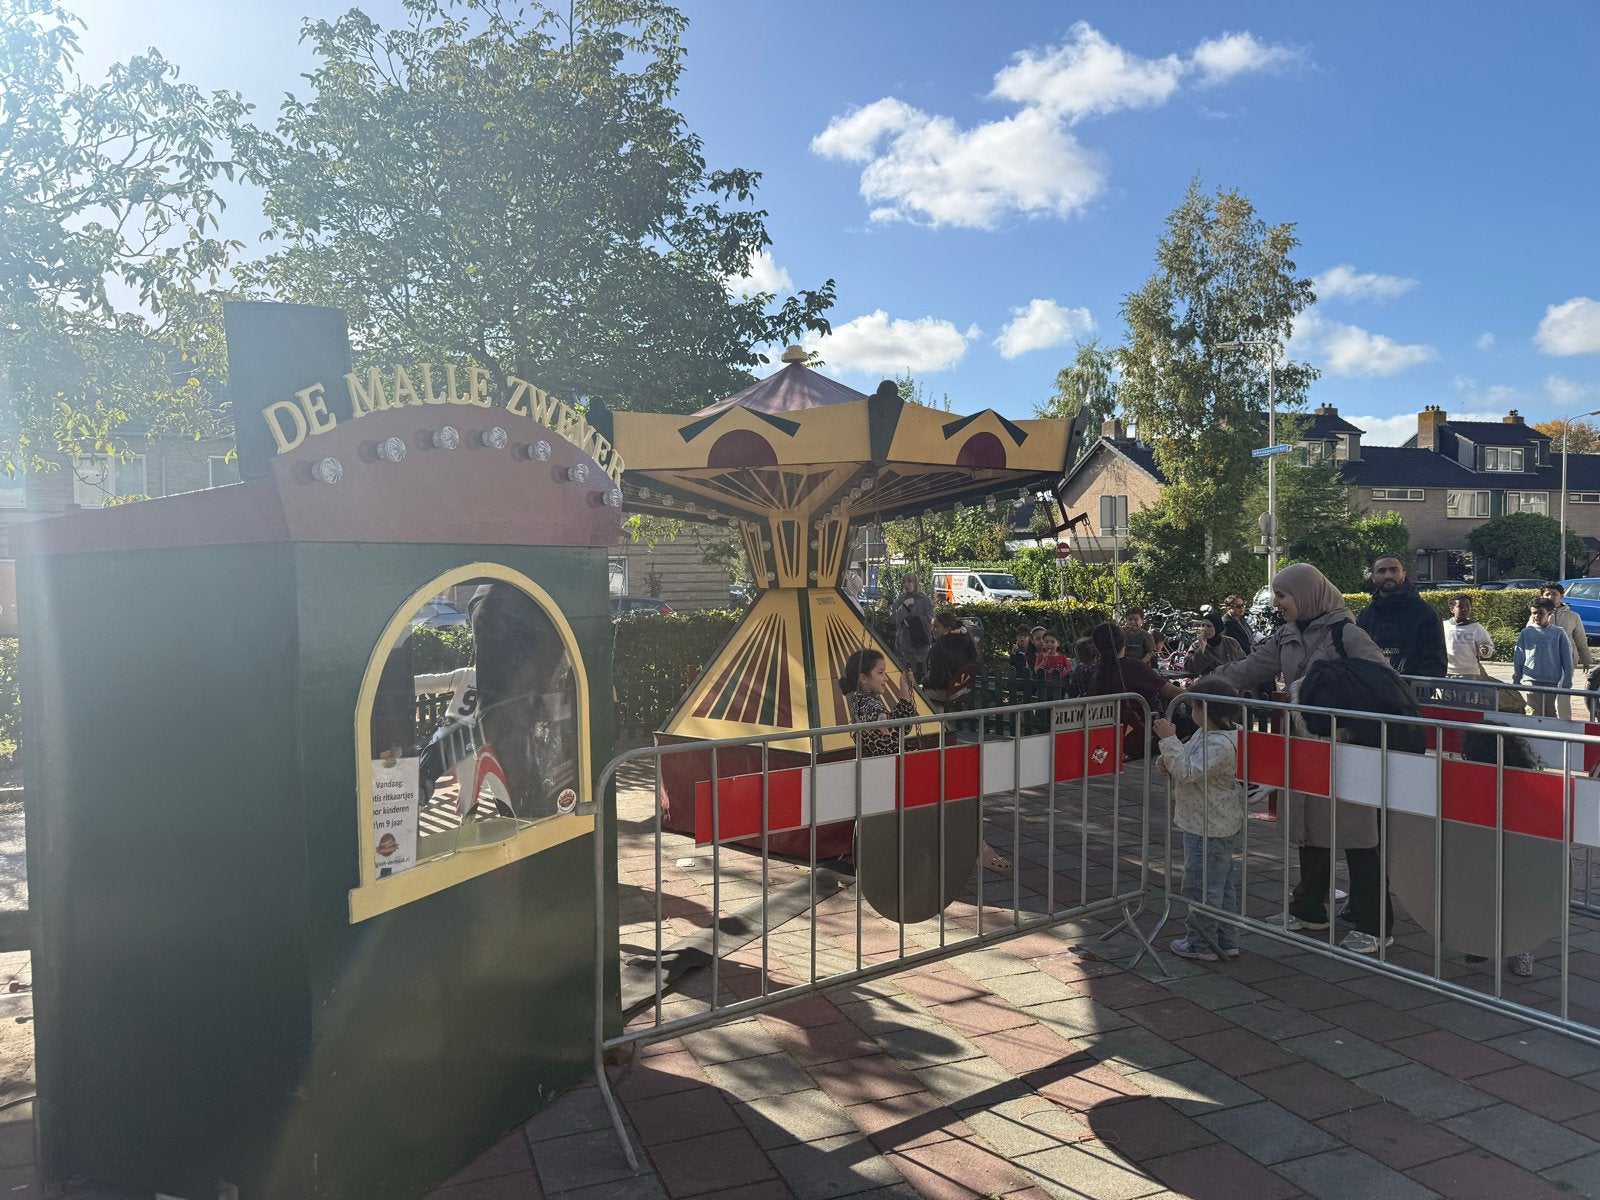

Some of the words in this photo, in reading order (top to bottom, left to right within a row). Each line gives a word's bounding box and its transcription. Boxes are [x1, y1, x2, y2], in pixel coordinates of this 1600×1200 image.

[262, 382, 337, 455] DE
[343, 362, 492, 418] MALLE
[506, 375, 625, 490] ZWEVER
[375, 780, 404, 788] Vandaag:
[383, 792, 414, 801] ritkaartjes
[382, 805, 410, 815] kinderen
[385, 819, 391, 828] 9
[391, 819, 403, 829] jaar
